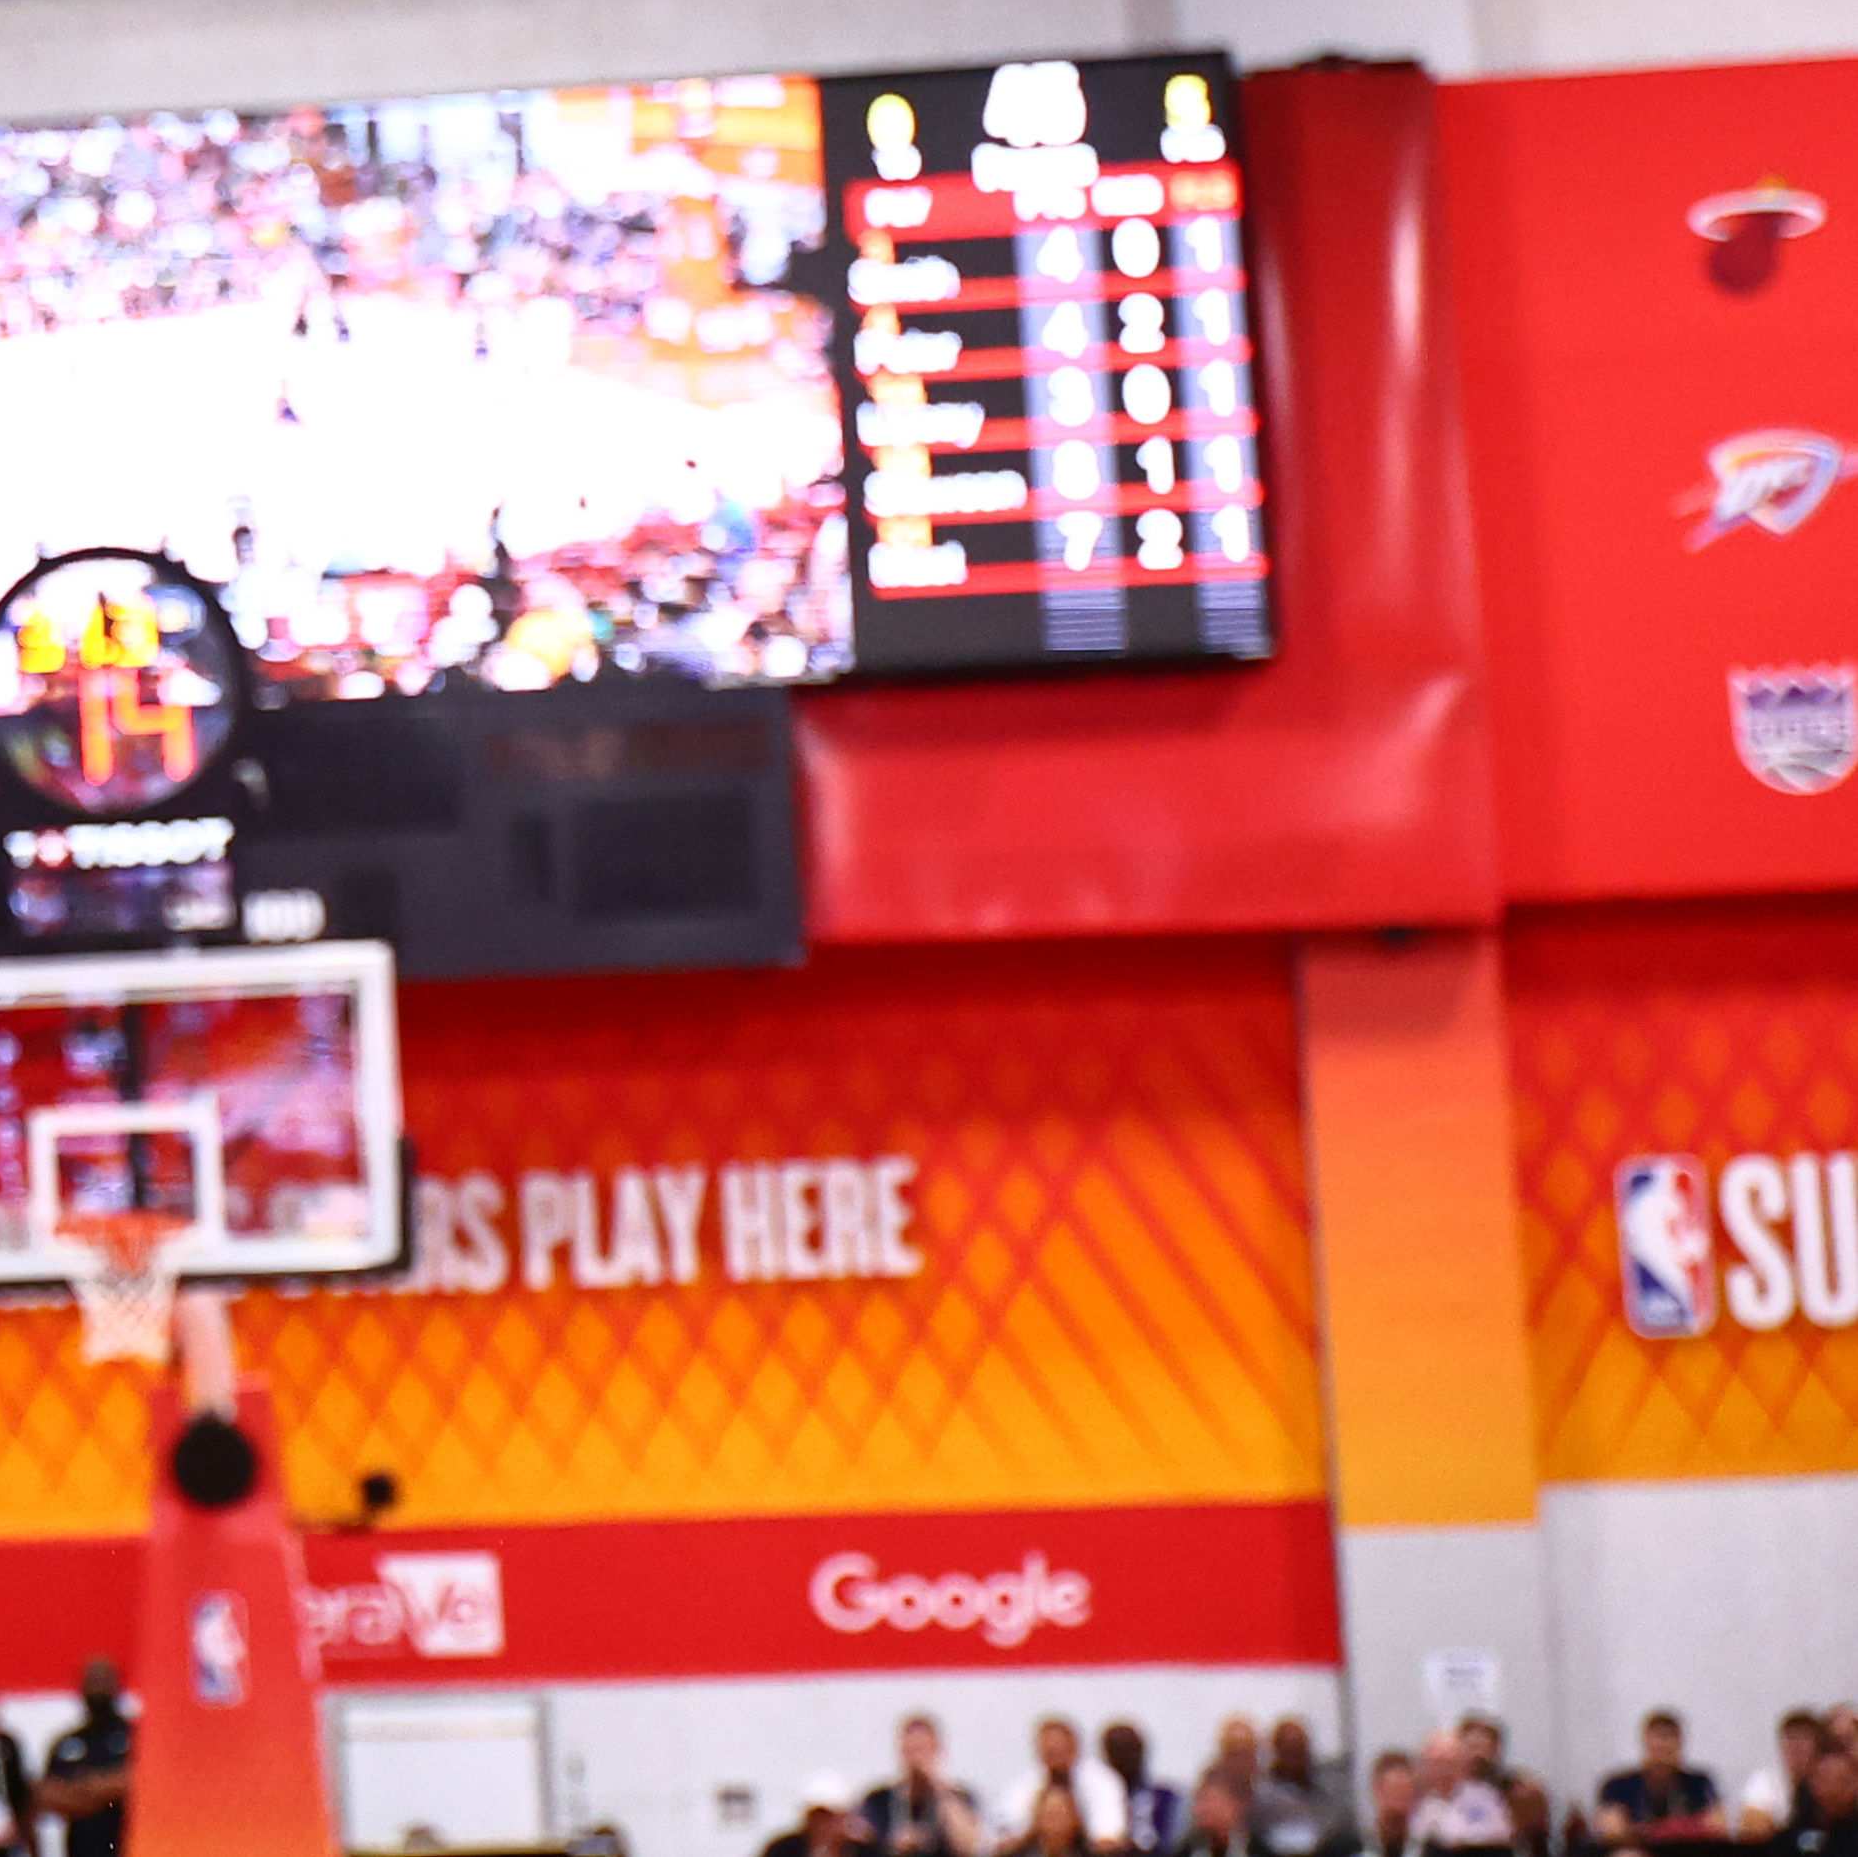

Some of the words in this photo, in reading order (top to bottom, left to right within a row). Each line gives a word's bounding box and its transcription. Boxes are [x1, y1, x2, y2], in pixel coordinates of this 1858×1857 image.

[519, 1163, 706, 1292] PLAY
[721, 1154, 925, 1284] HERE
[808, 1548, 1092, 1649] Google
